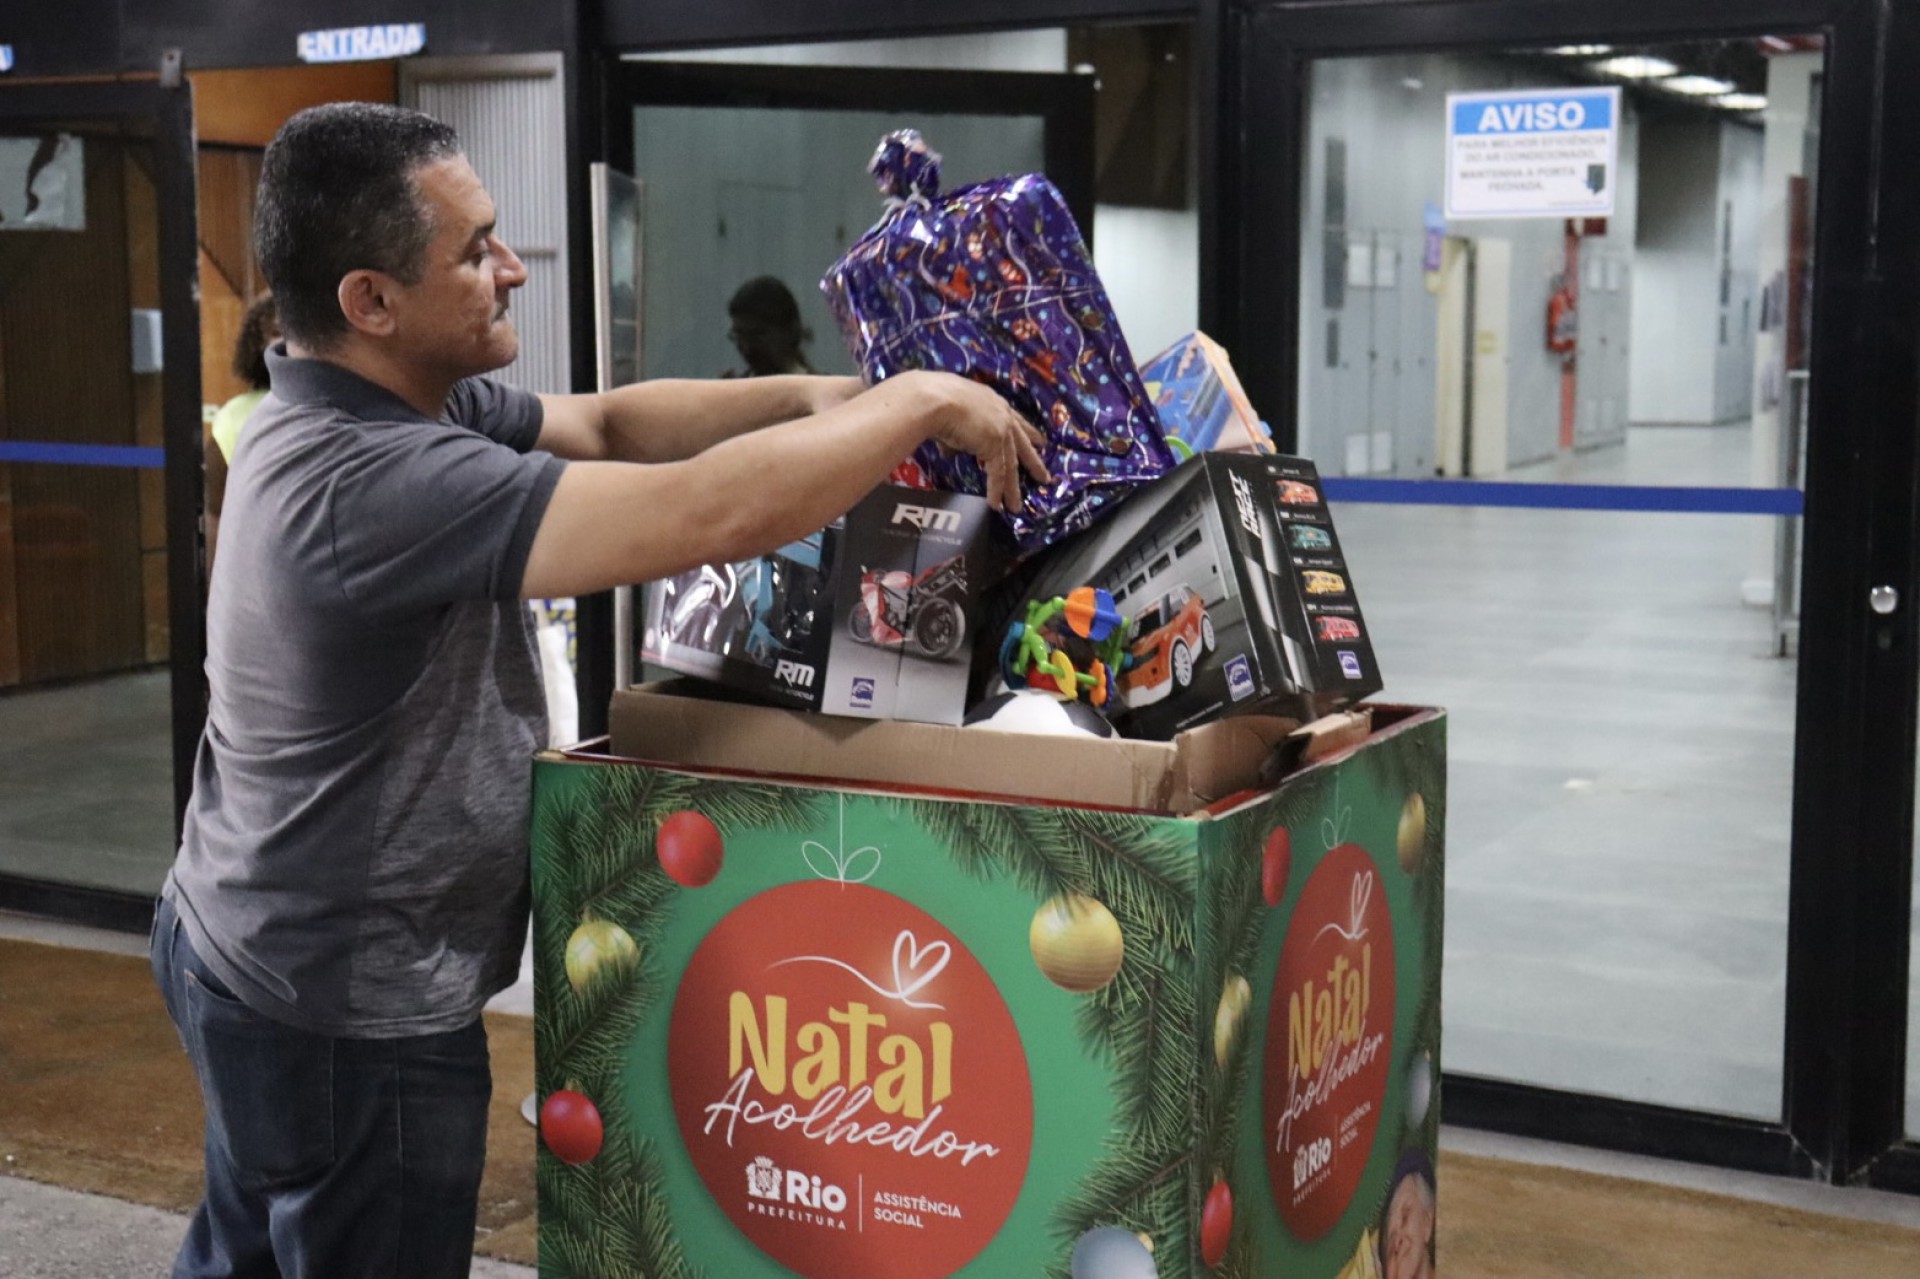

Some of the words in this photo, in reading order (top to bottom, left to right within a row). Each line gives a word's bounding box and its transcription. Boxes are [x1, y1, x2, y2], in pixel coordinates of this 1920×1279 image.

[299, 24, 423, 59] ENTRADA
[1478, 101, 1585, 132] AVISO
[891, 502, 961, 534] RM
[774, 659, 815, 687] RM
[1288, 942, 1371, 1080] Natal
[728, 991, 953, 1119] Natal
[1276, 1018, 1384, 1154] Acolhedor
[704, 1067, 1000, 1167] Acolhedor
[1309, 1137, 1332, 1177] Rio
[786, 1169, 847, 1213] Rio
[873, 1190, 962, 1219] ASSISTÊNCIA
[748, 1202, 847, 1230] PREFEITURA
[873, 1207, 924, 1228] SOCIAL
